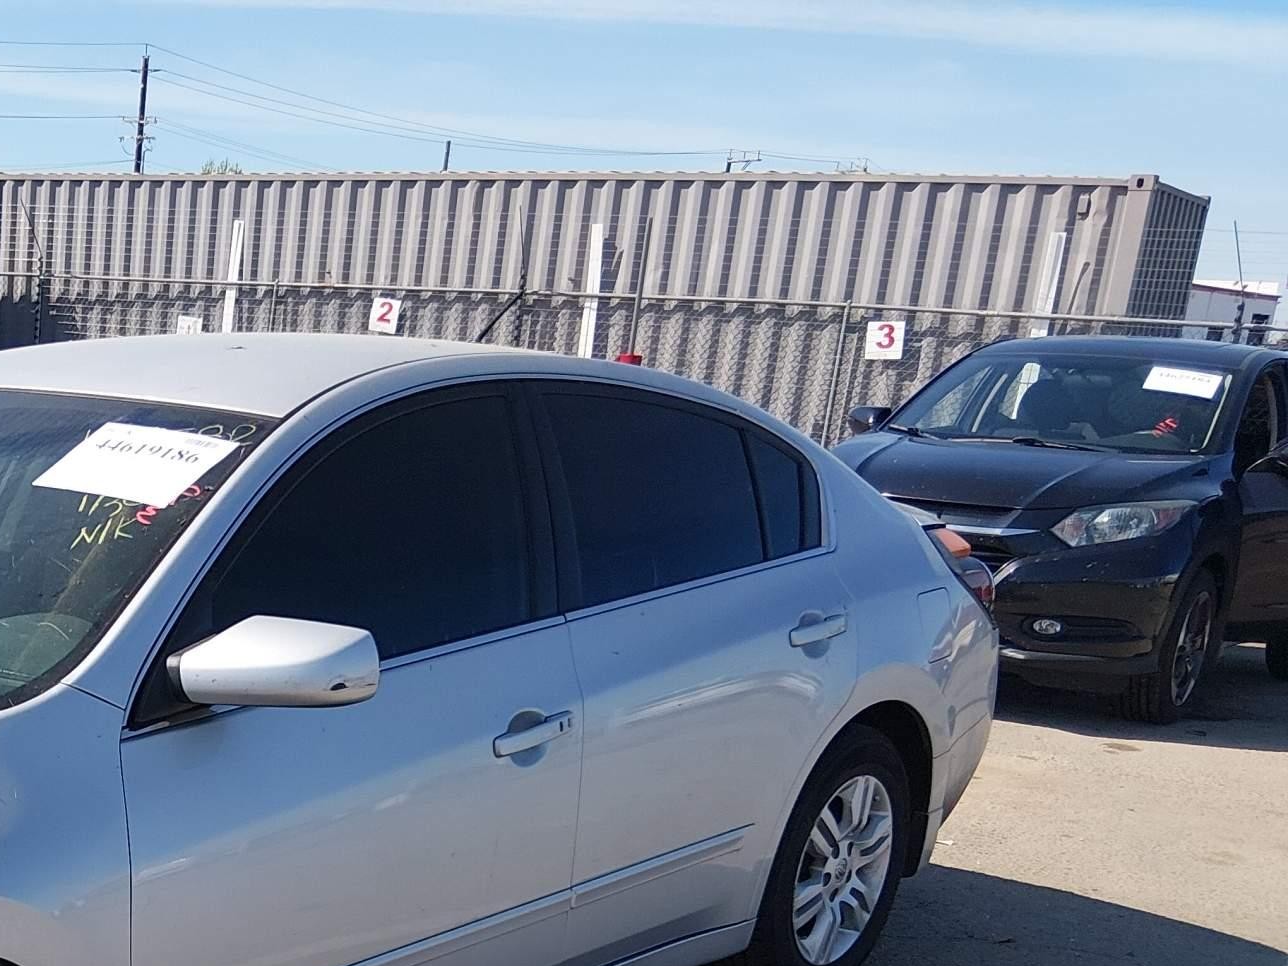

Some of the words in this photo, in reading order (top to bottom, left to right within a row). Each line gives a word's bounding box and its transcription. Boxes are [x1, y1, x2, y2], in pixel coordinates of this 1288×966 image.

[377, 302, 393, 323] 2
[875, 323, 895, 349] 3
[96, 439, 199, 464] 44619186
